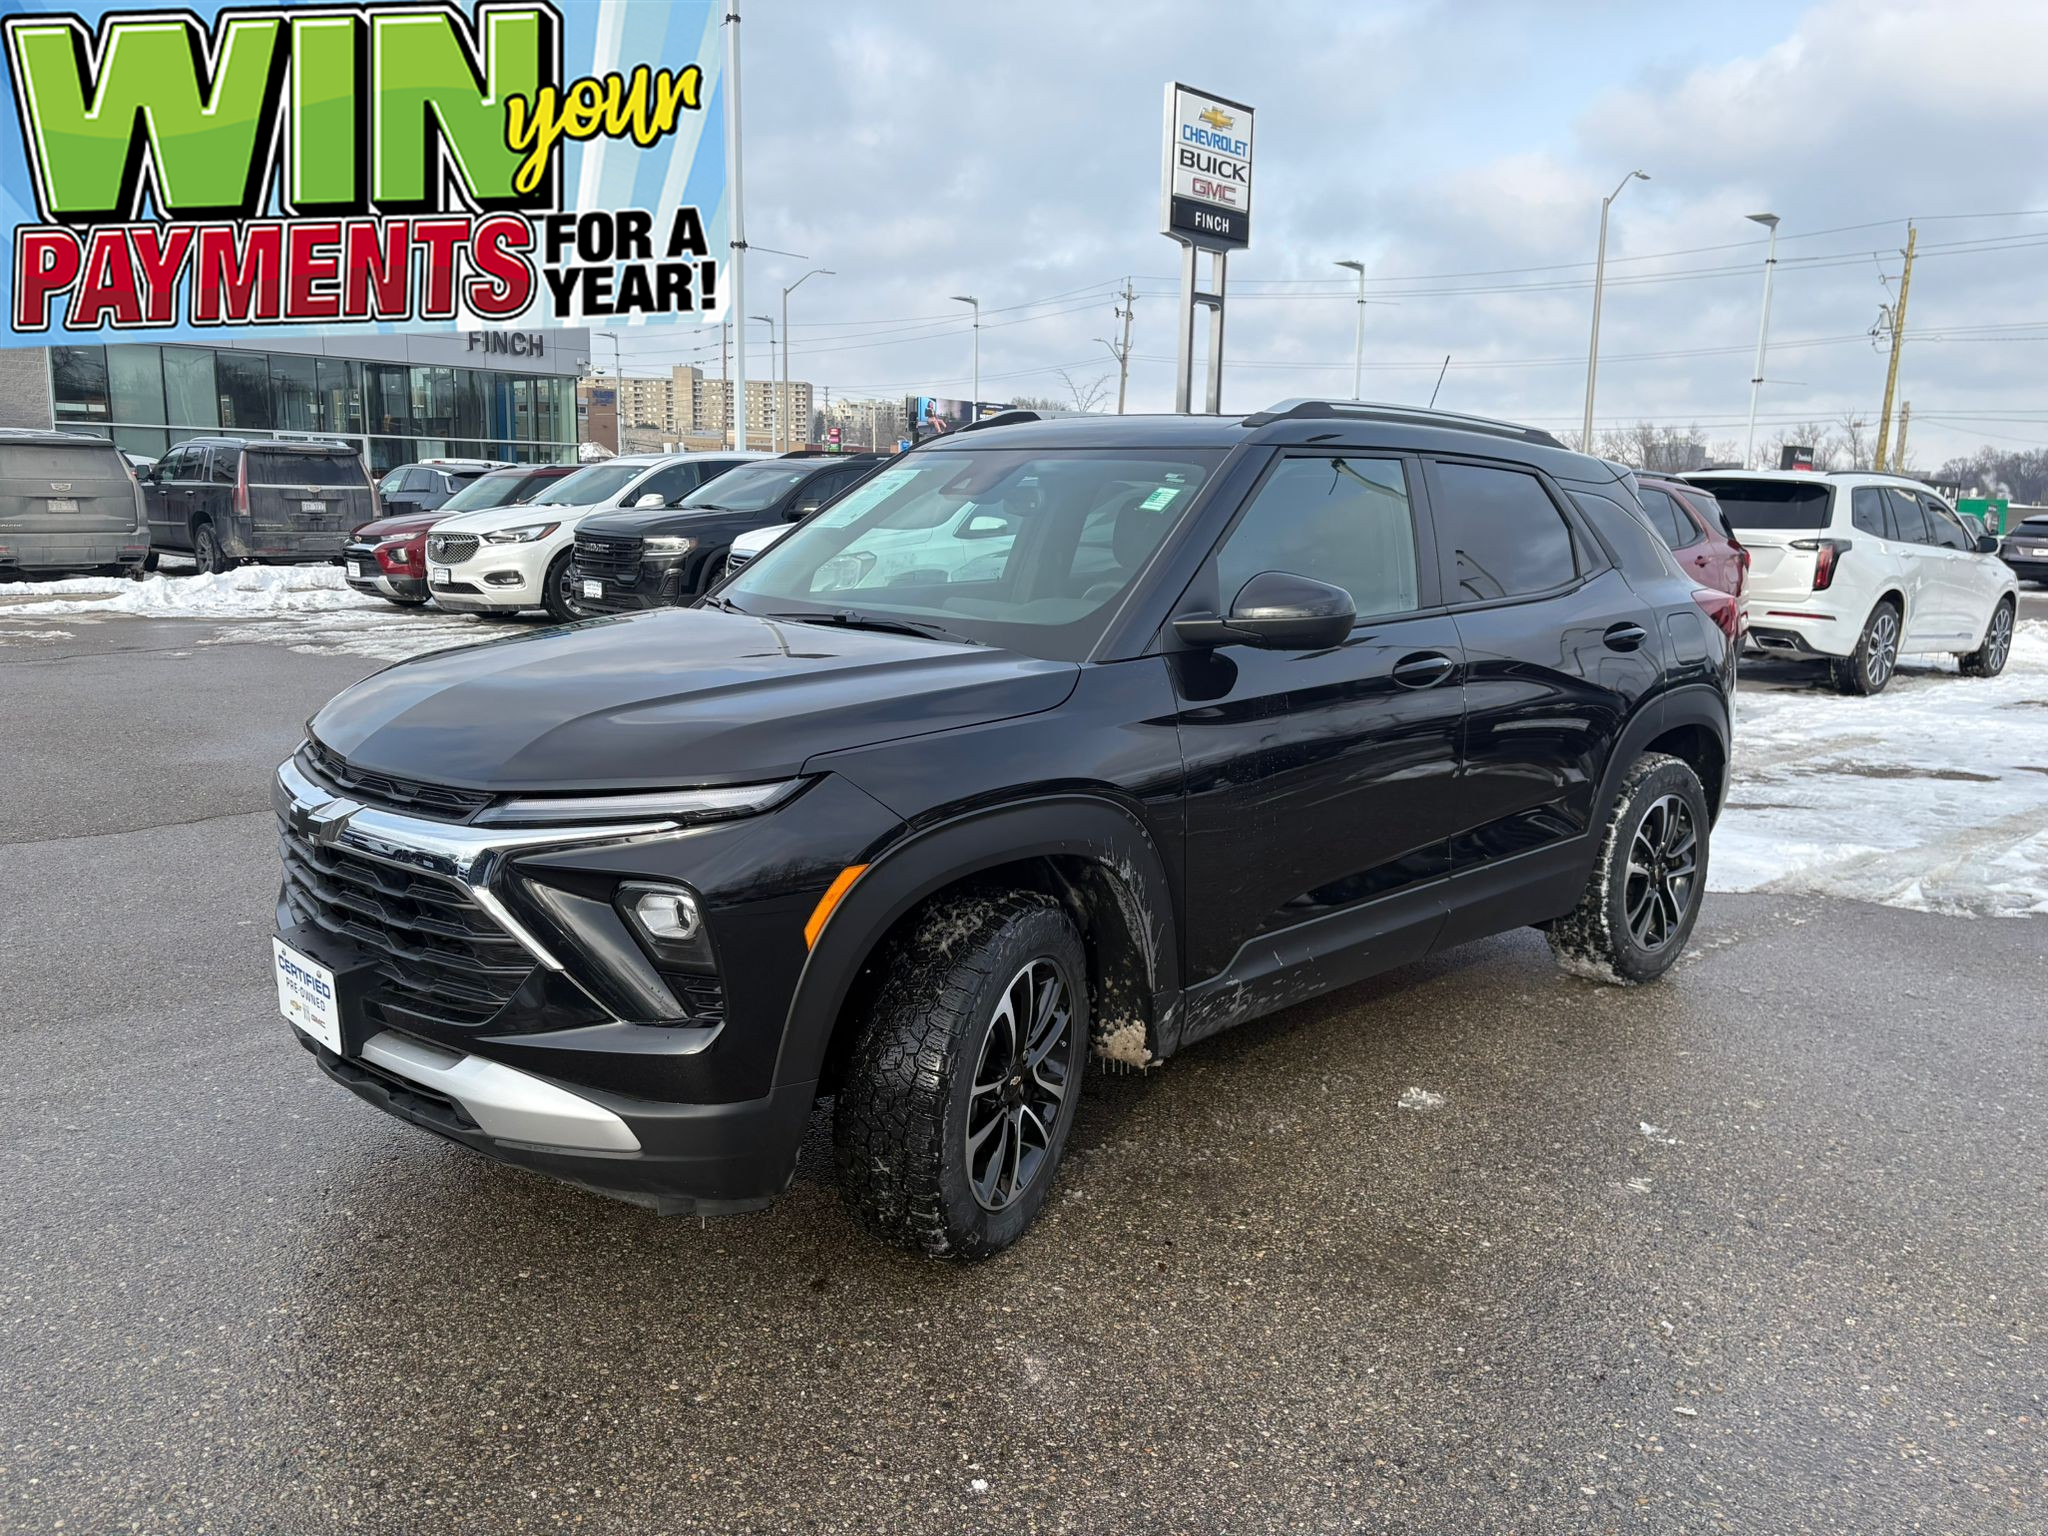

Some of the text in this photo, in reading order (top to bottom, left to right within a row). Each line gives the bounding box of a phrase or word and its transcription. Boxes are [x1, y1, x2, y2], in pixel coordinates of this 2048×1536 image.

[1182, 124, 1248, 158] CHEVROLET
[1180, 148, 1247, 183] BUICK
[1192, 177, 1237, 205] GMC
[1195, 211, 1230, 234] FINCH
[468, 330, 544, 357] FINCH
[278, 954, 331, 1000] CERTIFIED
[286, 976, 326, 1012] PRE-OWNED
